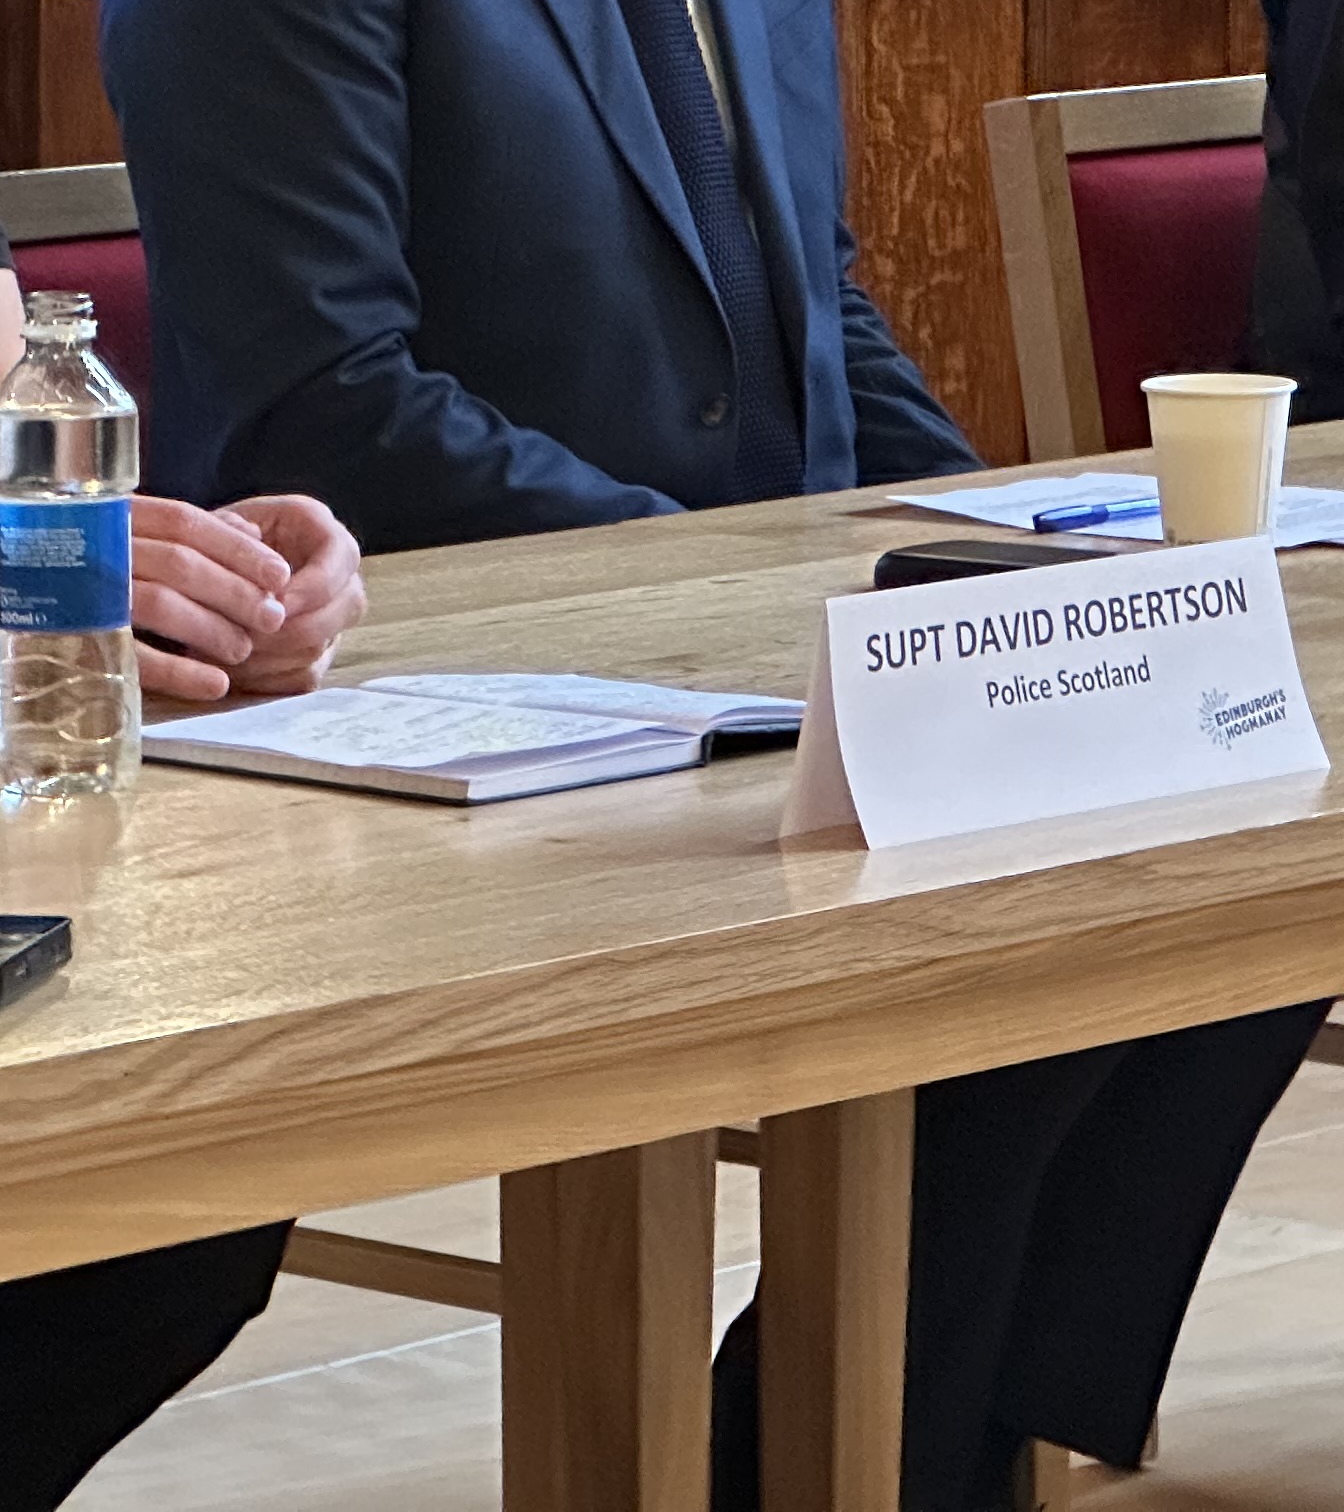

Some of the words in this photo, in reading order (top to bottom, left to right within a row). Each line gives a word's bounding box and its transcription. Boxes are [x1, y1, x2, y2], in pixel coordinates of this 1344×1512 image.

[866, 623, 946, 673] SUPT
[956, 608, 1054, 659] DAVID
[1064, 576, 1248, 642] ROBERTSON
[985, 675, 1053, 708] Police
[1057, 654, 1152, 697] Scotland
[1214, 688, 1287, 727] EDINBURGH'S
[1224, 705, 1287, 740] HOGMANAY
